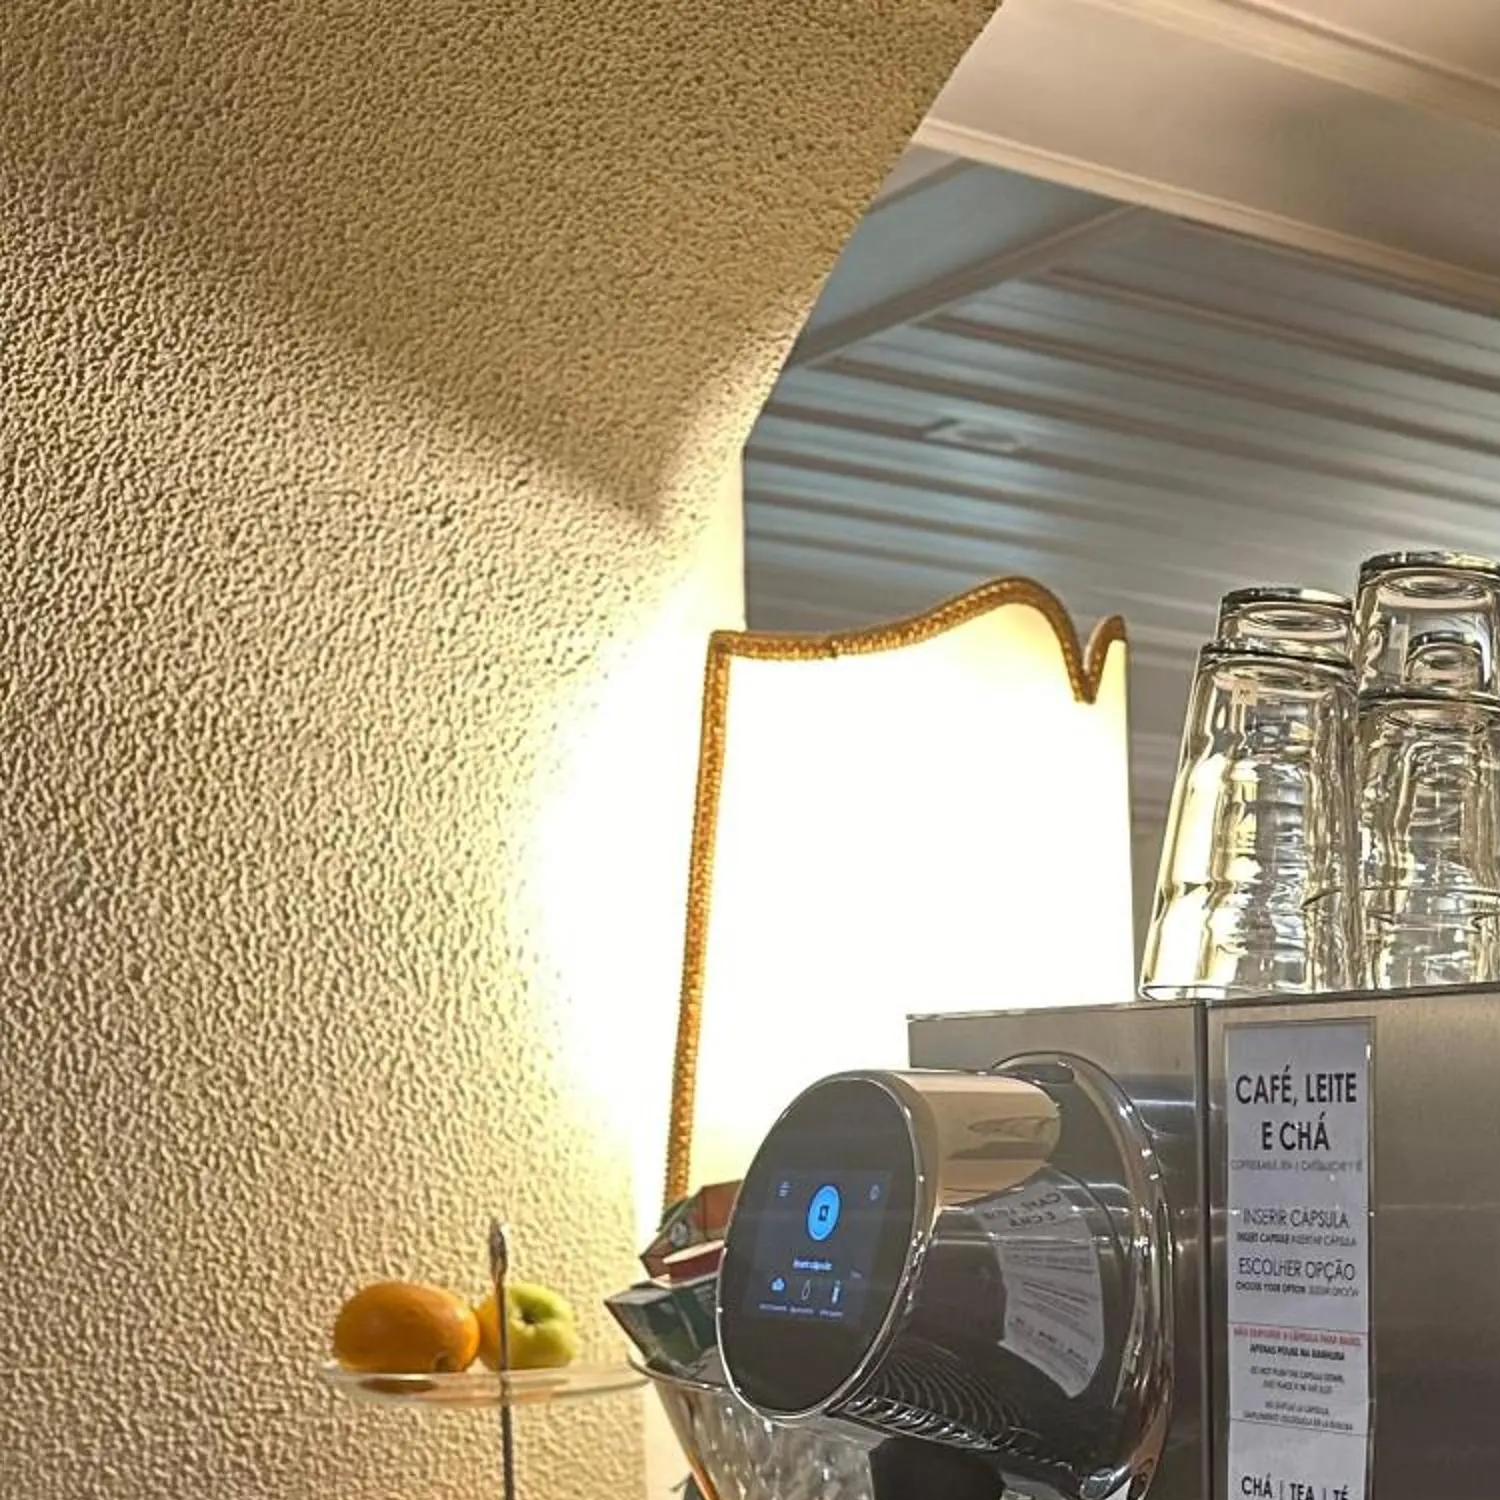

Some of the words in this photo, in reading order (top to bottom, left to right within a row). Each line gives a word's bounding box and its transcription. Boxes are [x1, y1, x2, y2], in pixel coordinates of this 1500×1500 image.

[1235, 1065, 1299, 1106] CAFÉ,
[1305, 1072, 1357, 1104] LEITE
[1261, 1122, 1273, 1150] E
[1279, 1112, 1331, 1151] CHÁ
[1243, 1207, 1287, 1226] INSERIR
[1289, 1206, 1350, 1229] CÁPSULA
[1238, 1256, 1302, 1277] ESCOLHER
[1305, 1258, 1356, 1284] OPÇÃO
[1241, 1472, 1273, 1499] CHÁ
